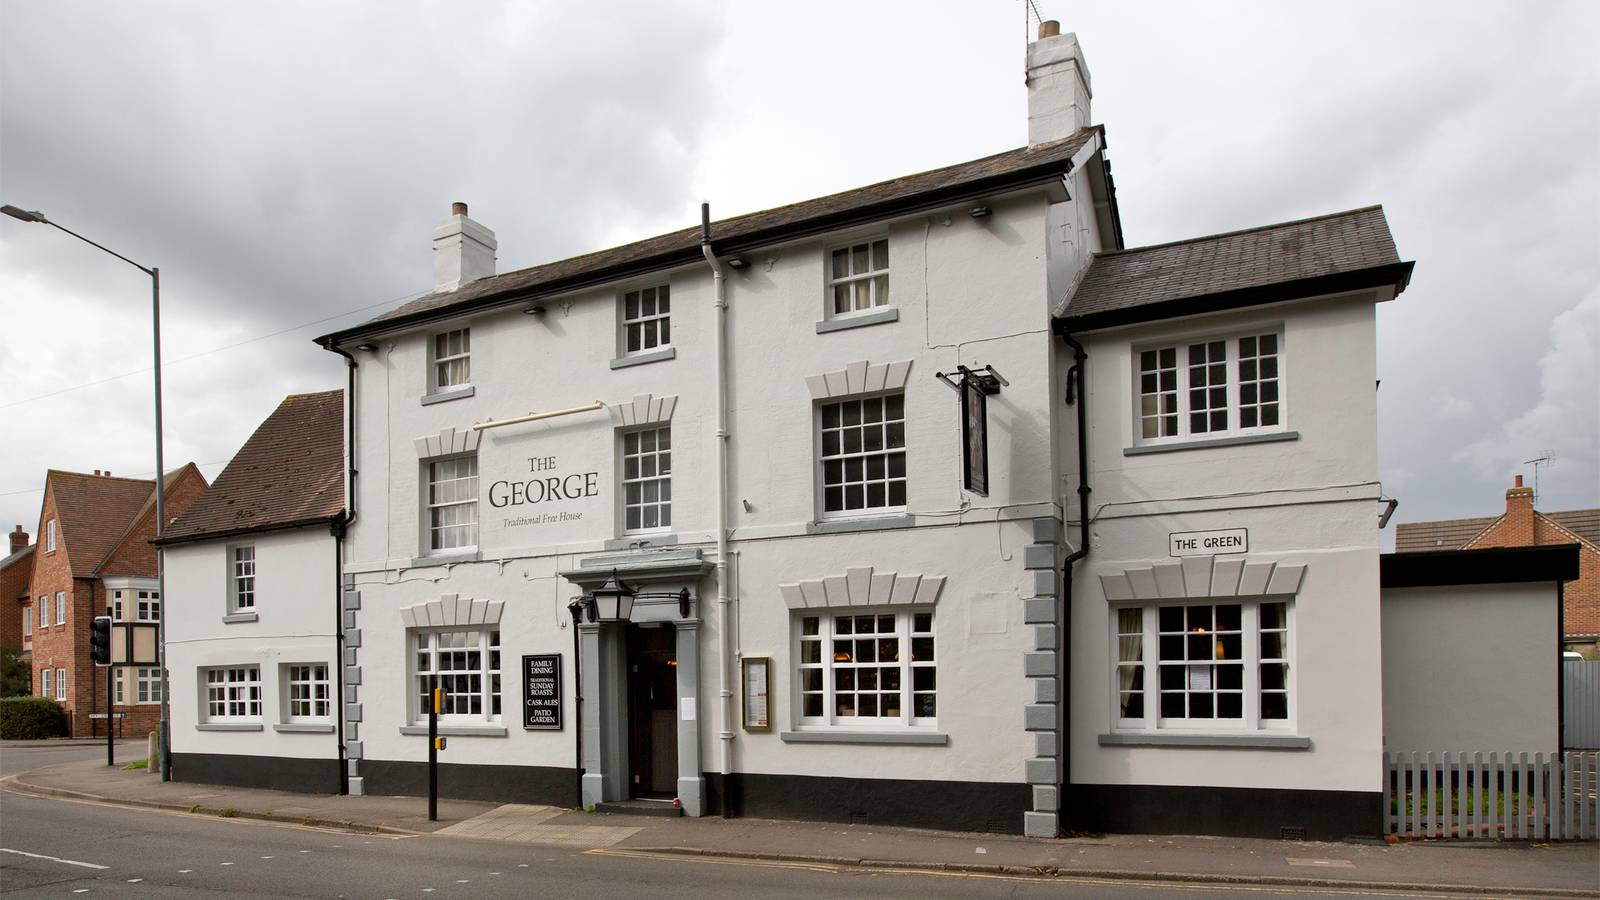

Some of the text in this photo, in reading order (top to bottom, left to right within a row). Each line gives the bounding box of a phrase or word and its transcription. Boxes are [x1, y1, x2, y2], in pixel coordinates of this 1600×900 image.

[527, 456, 556, 472] THE
[488, 472, 599, 508] GEORGE
[503, 511, 583, 528] Traditional Free House
[1175, 535, 1242, 550] THE GREEN
